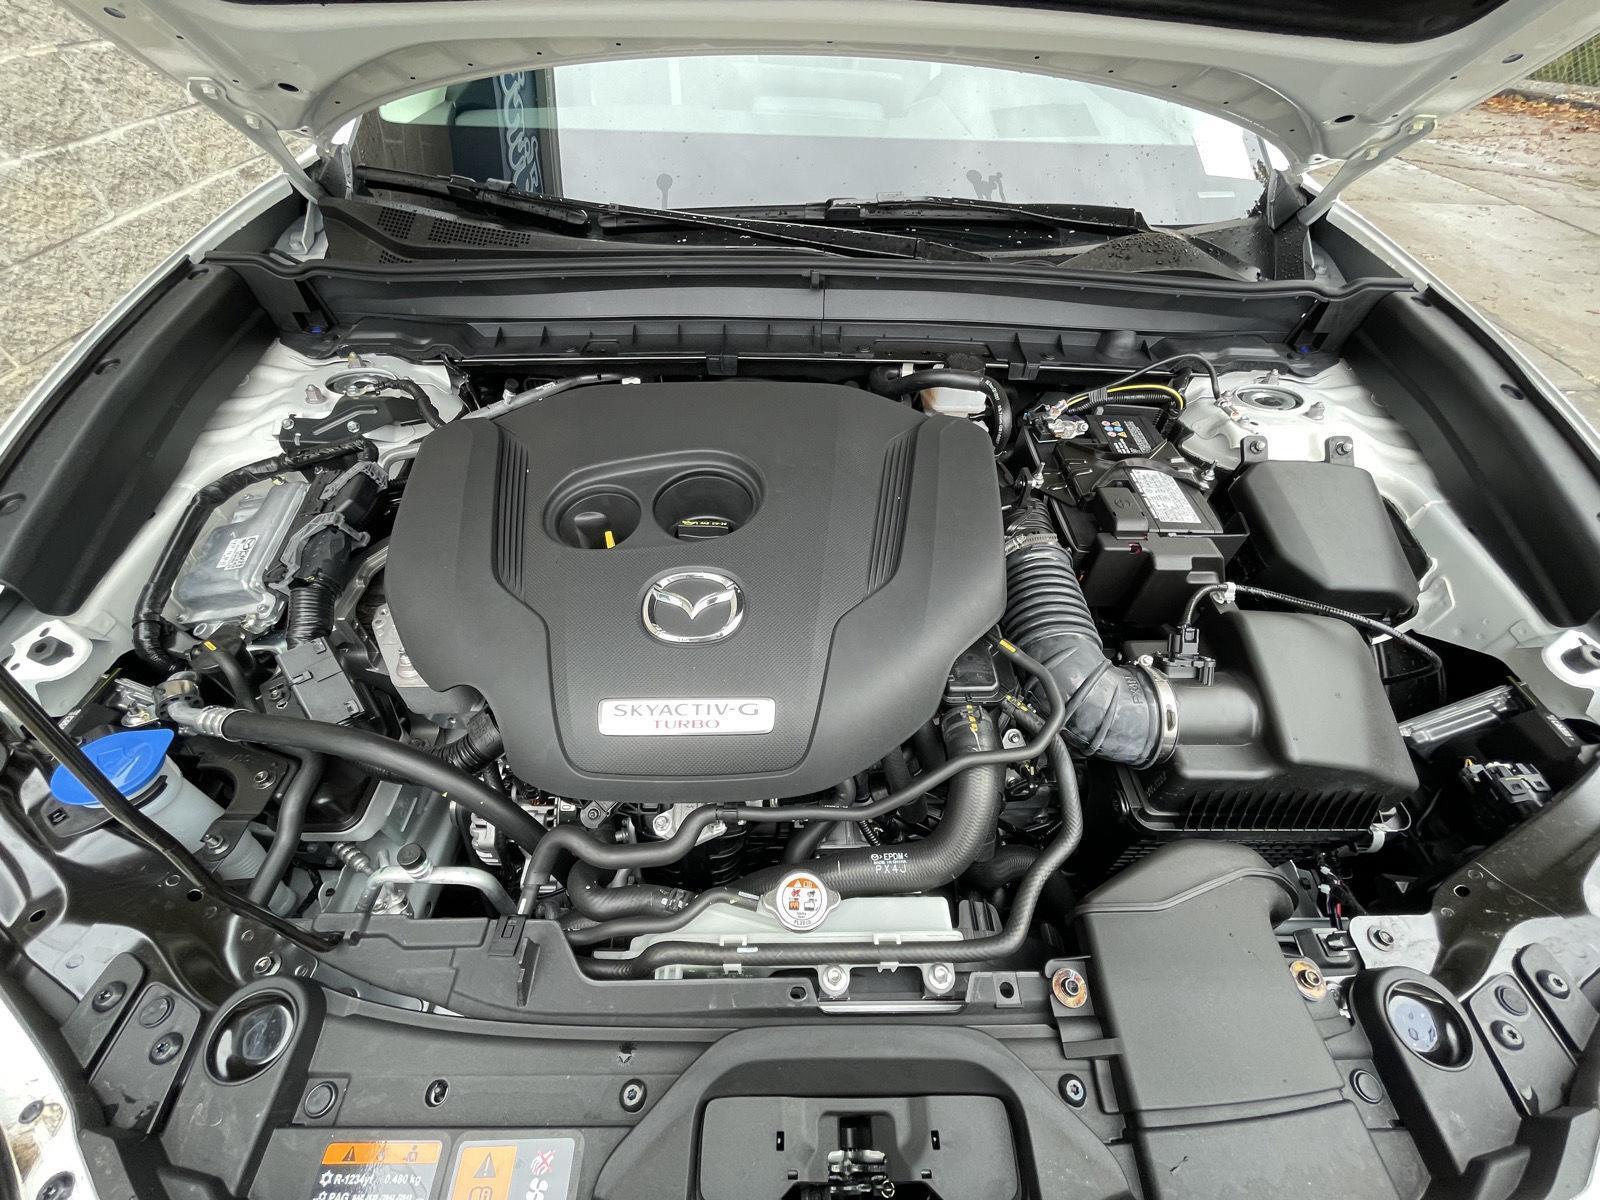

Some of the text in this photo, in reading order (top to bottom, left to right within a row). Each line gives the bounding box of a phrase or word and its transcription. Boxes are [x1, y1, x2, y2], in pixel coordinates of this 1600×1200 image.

[613, 703, 760, 717] SKYACTIV-G
[655, 719, 721, 729] TURBO
[875, 864, 907, 874] PX4J
[333, 1173, 374, 1187] R-1234yf
[409, 1174, 422, 1187] kg
